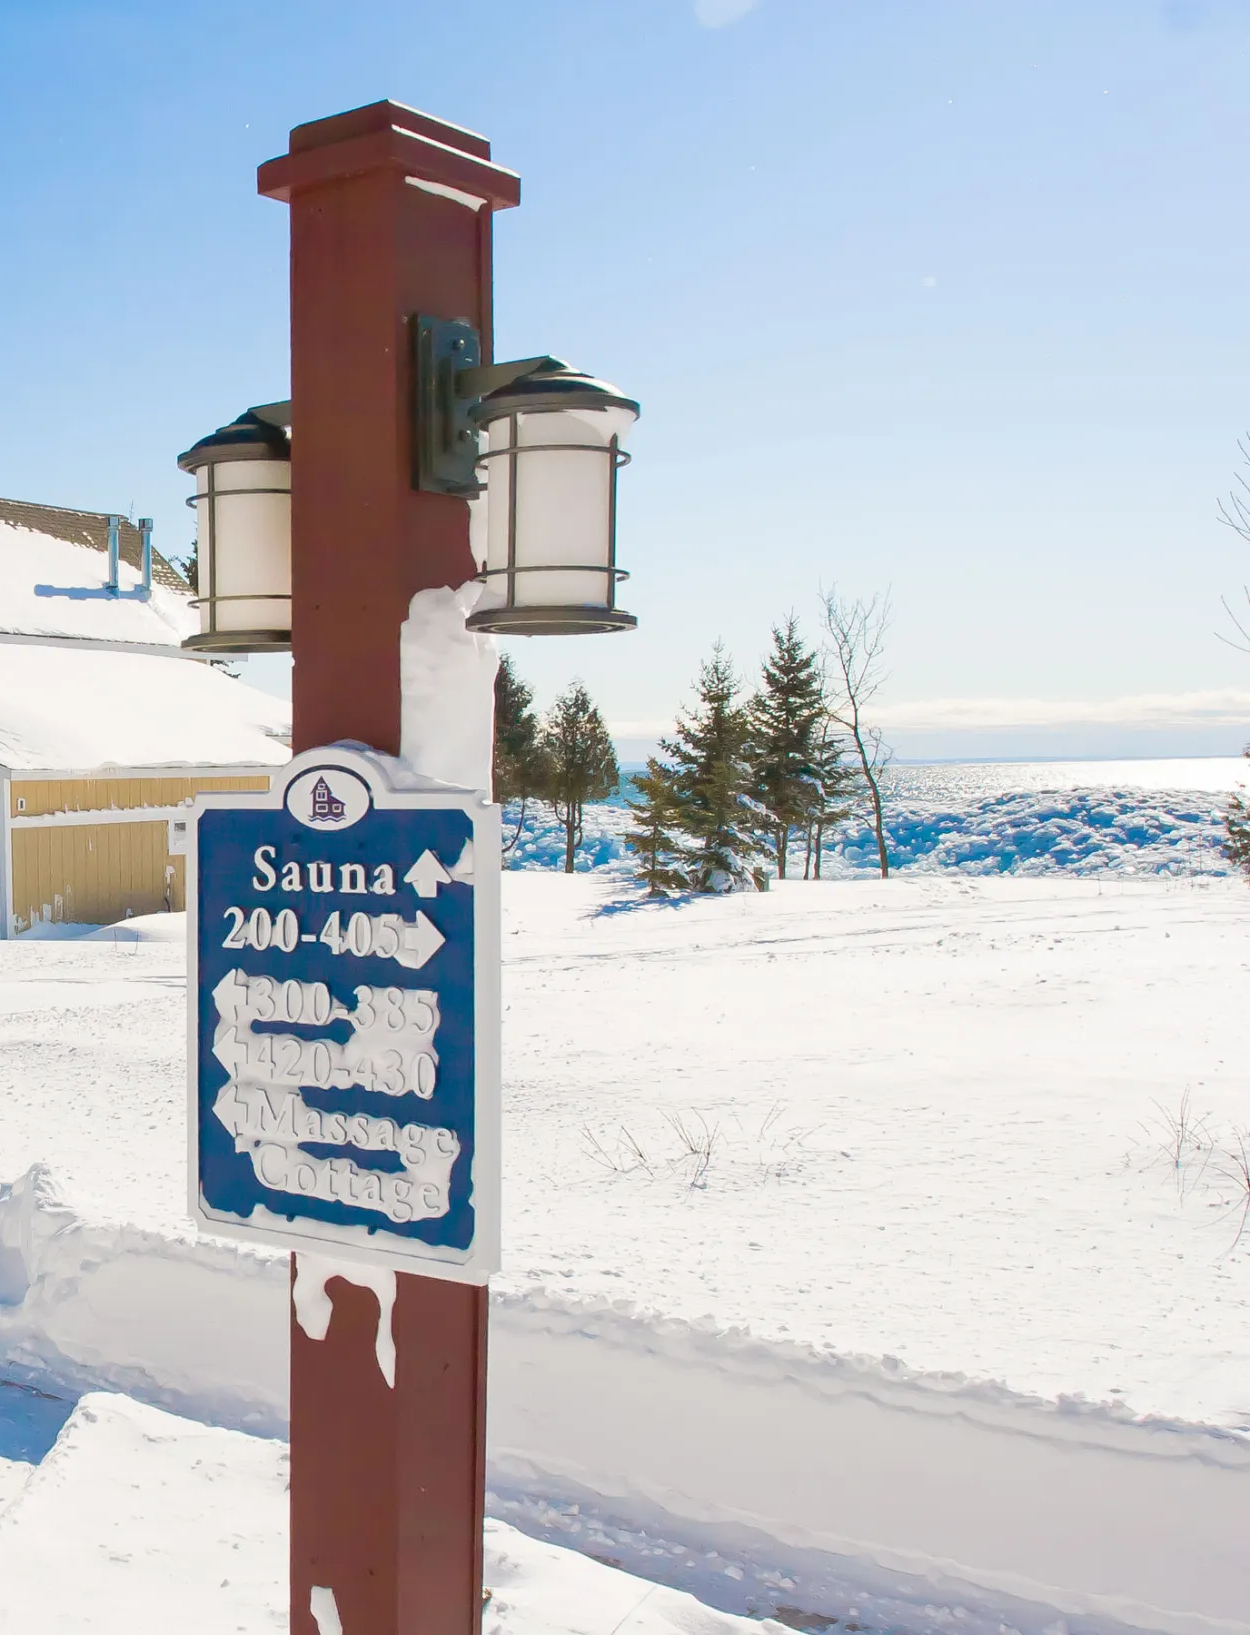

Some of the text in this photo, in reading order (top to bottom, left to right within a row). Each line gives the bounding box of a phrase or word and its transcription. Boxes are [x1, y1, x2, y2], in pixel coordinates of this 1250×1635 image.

[252, 845, 396, 895] Sauna
[222, 906, 401, 958] 200-405
[254, 977, 439, 1034] 300-385
[256, 1035, 437, 1100] 420-430
[254, 1087, 458, 1165] Massage
[258, 1143, 441, 1222] Cottage
